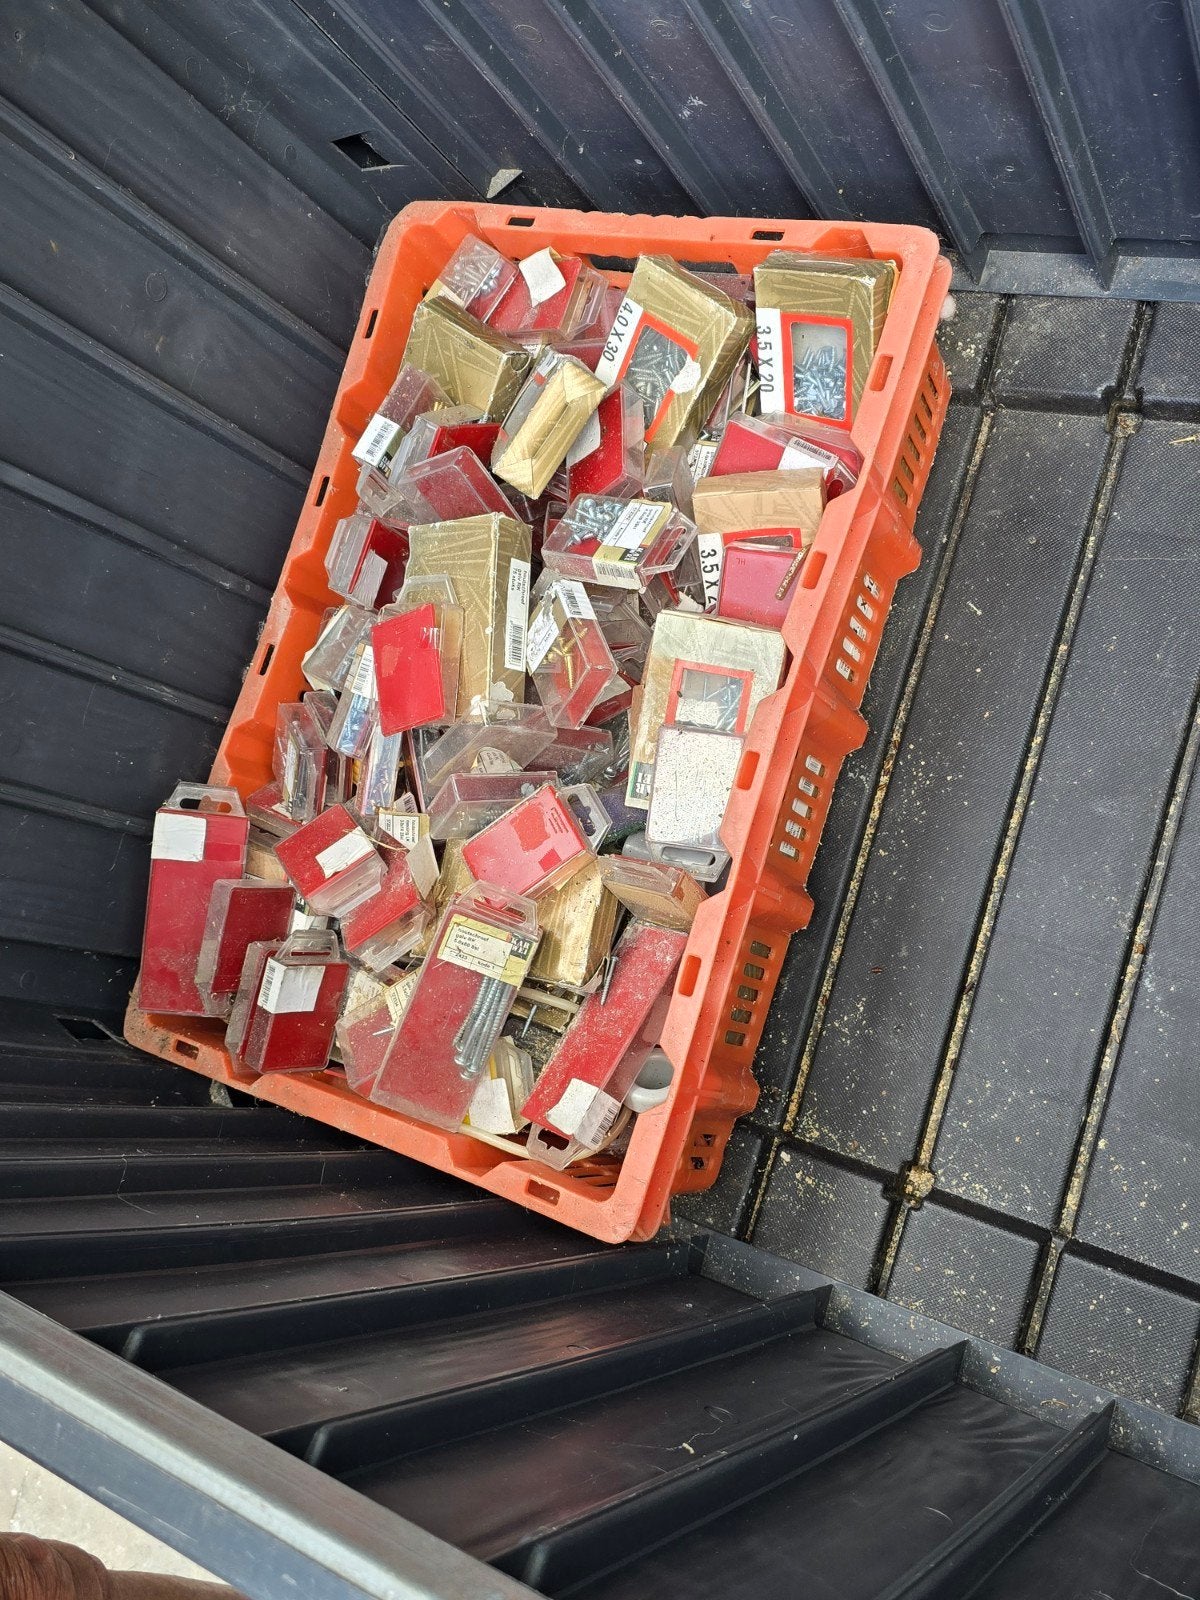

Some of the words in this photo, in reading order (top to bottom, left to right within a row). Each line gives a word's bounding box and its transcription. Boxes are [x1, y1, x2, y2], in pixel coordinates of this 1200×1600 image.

[616, 302, 633, 327] 4.0
[611, 326, 625, 342] X
[757, 326, 773, 351] 3.5
[603, 341, 618, 362] 30
[758, 357, 774, 368] X
[759, 373, 774, 393] 20
[700, 549, 719, 573] 3.5
[705, 579, 720, 590] X
[511, 937, 531, 948] KAR
